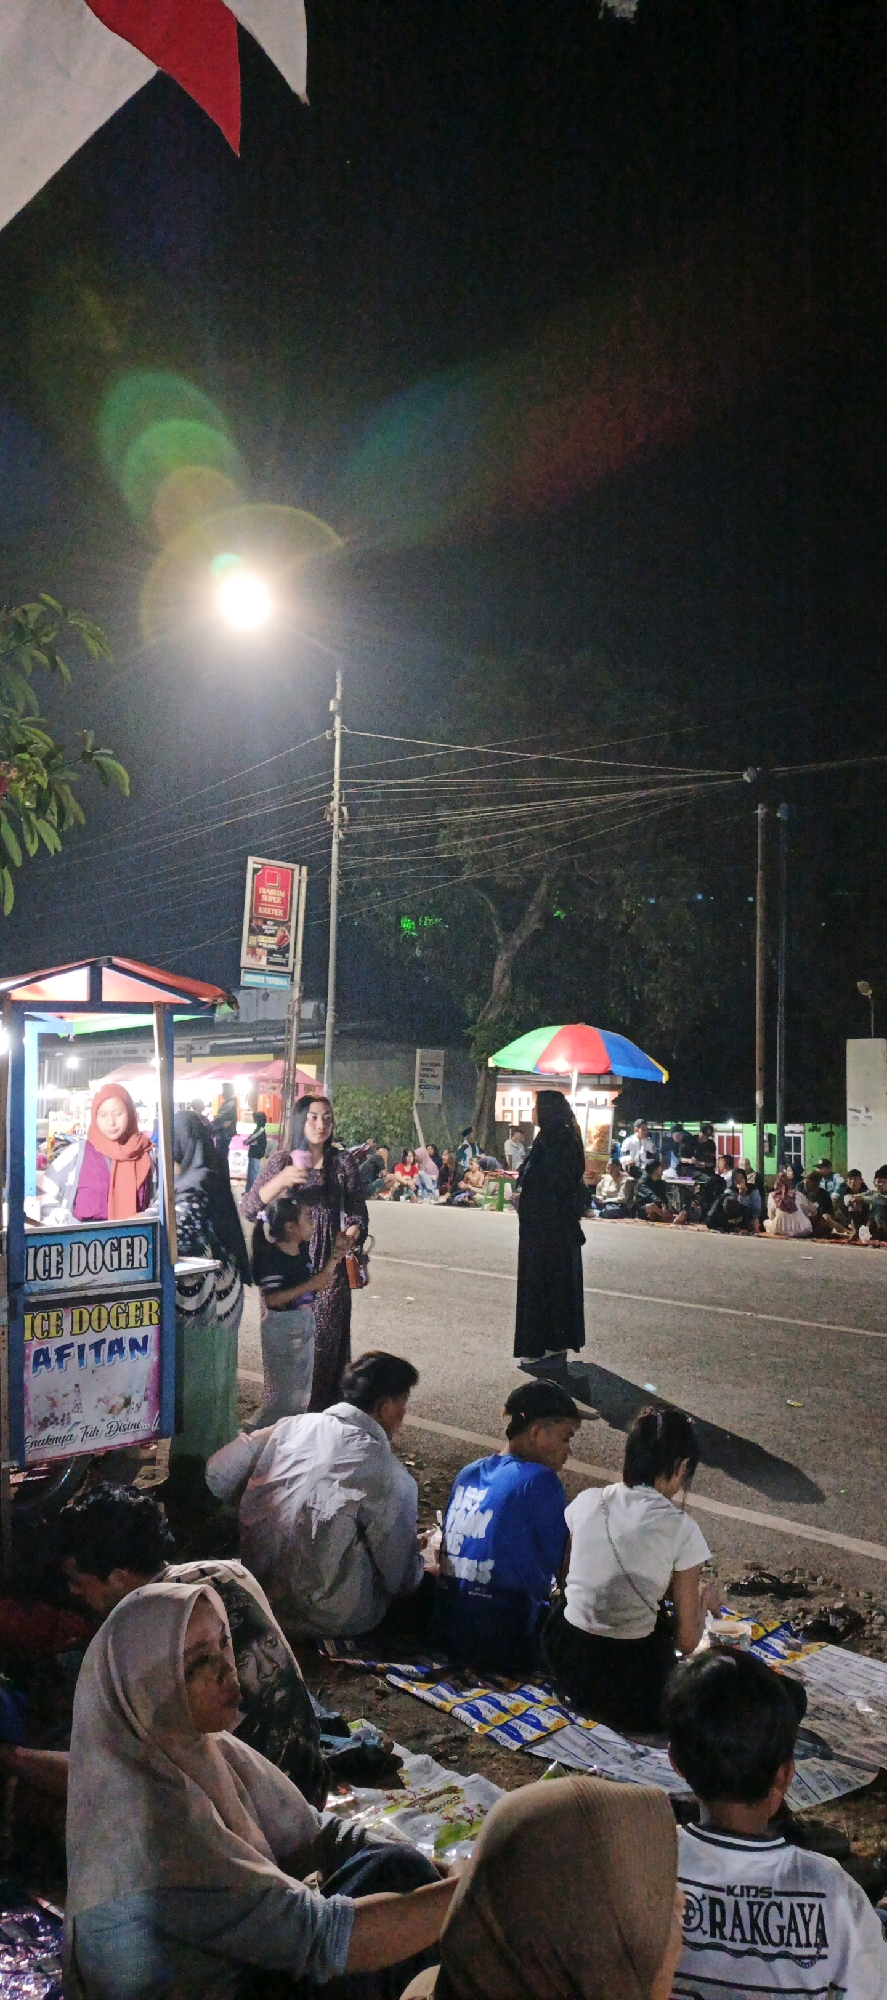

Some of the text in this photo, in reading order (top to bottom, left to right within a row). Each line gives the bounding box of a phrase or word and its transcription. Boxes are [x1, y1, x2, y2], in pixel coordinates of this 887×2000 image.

[261, 894, 282, 904] SUPER
[26, 1235, 149, 1281] ICE DOGER
[24, 1299, 160, 1342] ICE DOGER
[32, 1334, 151, 1376] AFITAN
[79, 1424, 102, 1443] Tuh
[726, 1885, 773, 1899] KIDS
